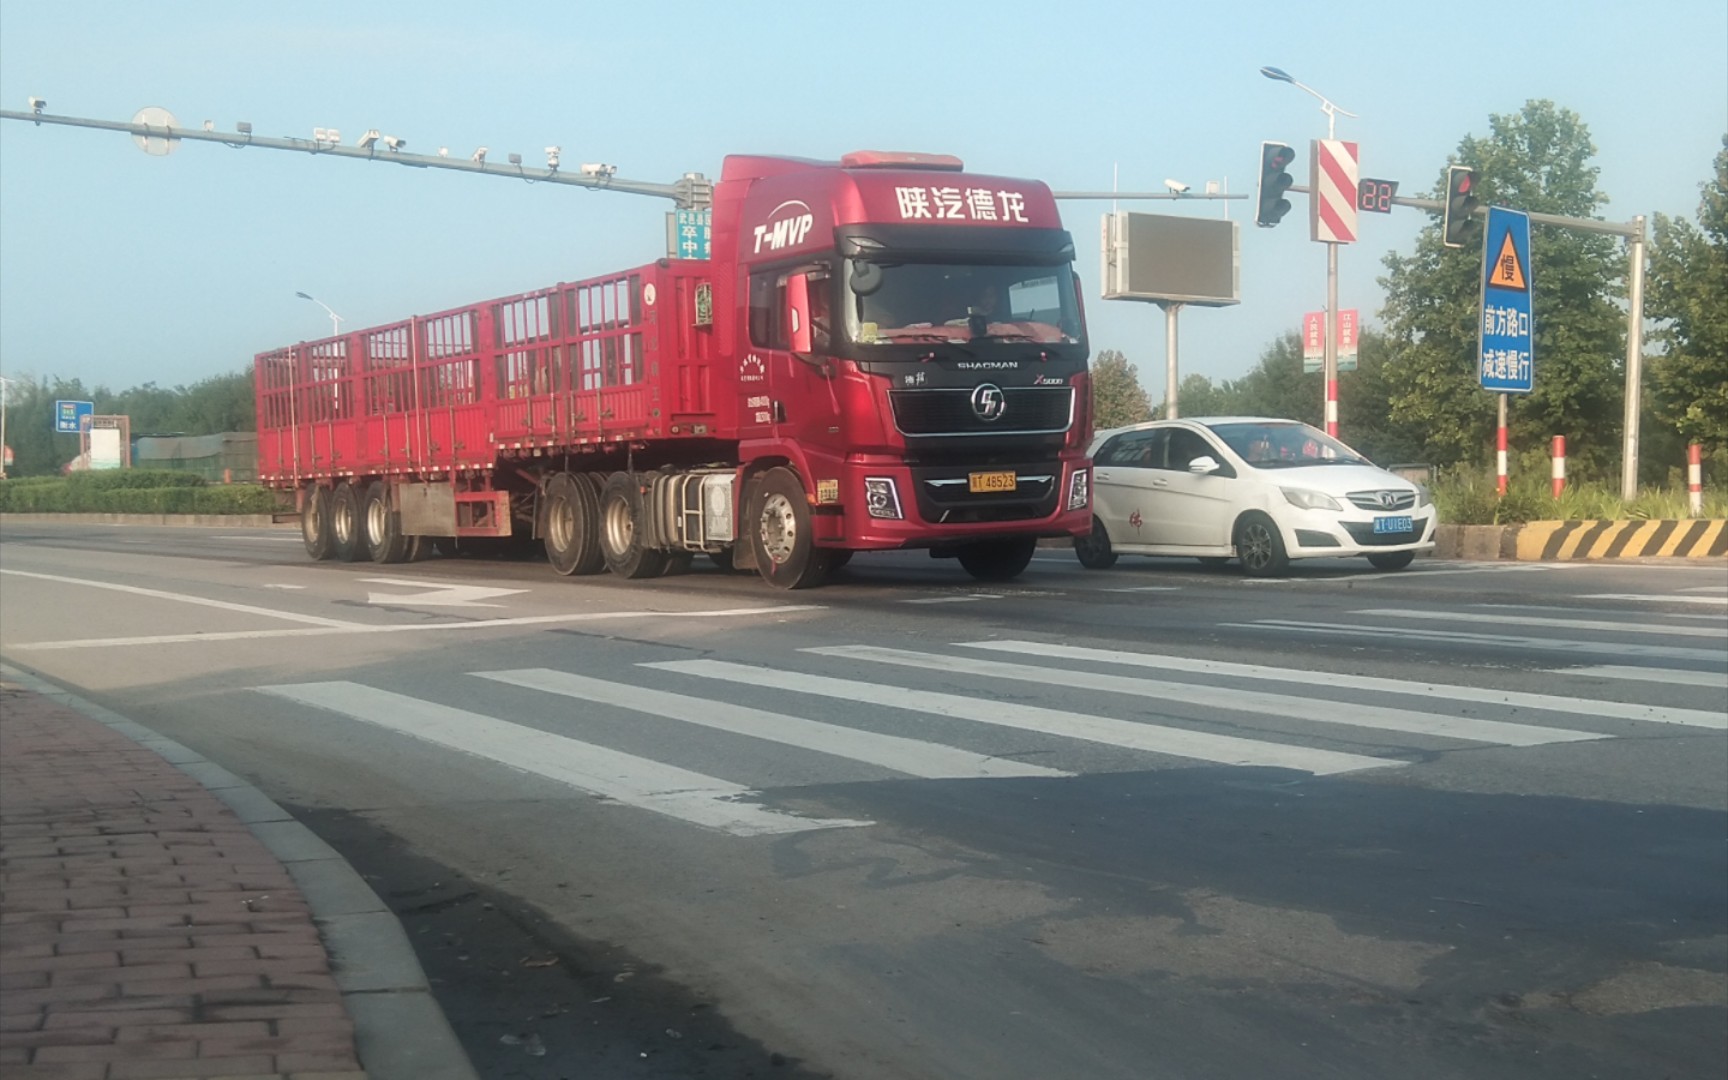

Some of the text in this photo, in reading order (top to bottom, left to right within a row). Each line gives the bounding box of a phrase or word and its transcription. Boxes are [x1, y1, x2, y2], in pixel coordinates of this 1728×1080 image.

[895, 186, 1029, 223] 陕汽德龙
[682, 226, 698, 260] 卒中
[754, 214, 813, 254] T-MVP
[1501, 254, 1515, 282] 慢
[1484, 305, 1529, 338] 前方路口
[957, 361, 1019, 369] SHACMAN
[1482, 349, 1530, 381] 减速慢行
